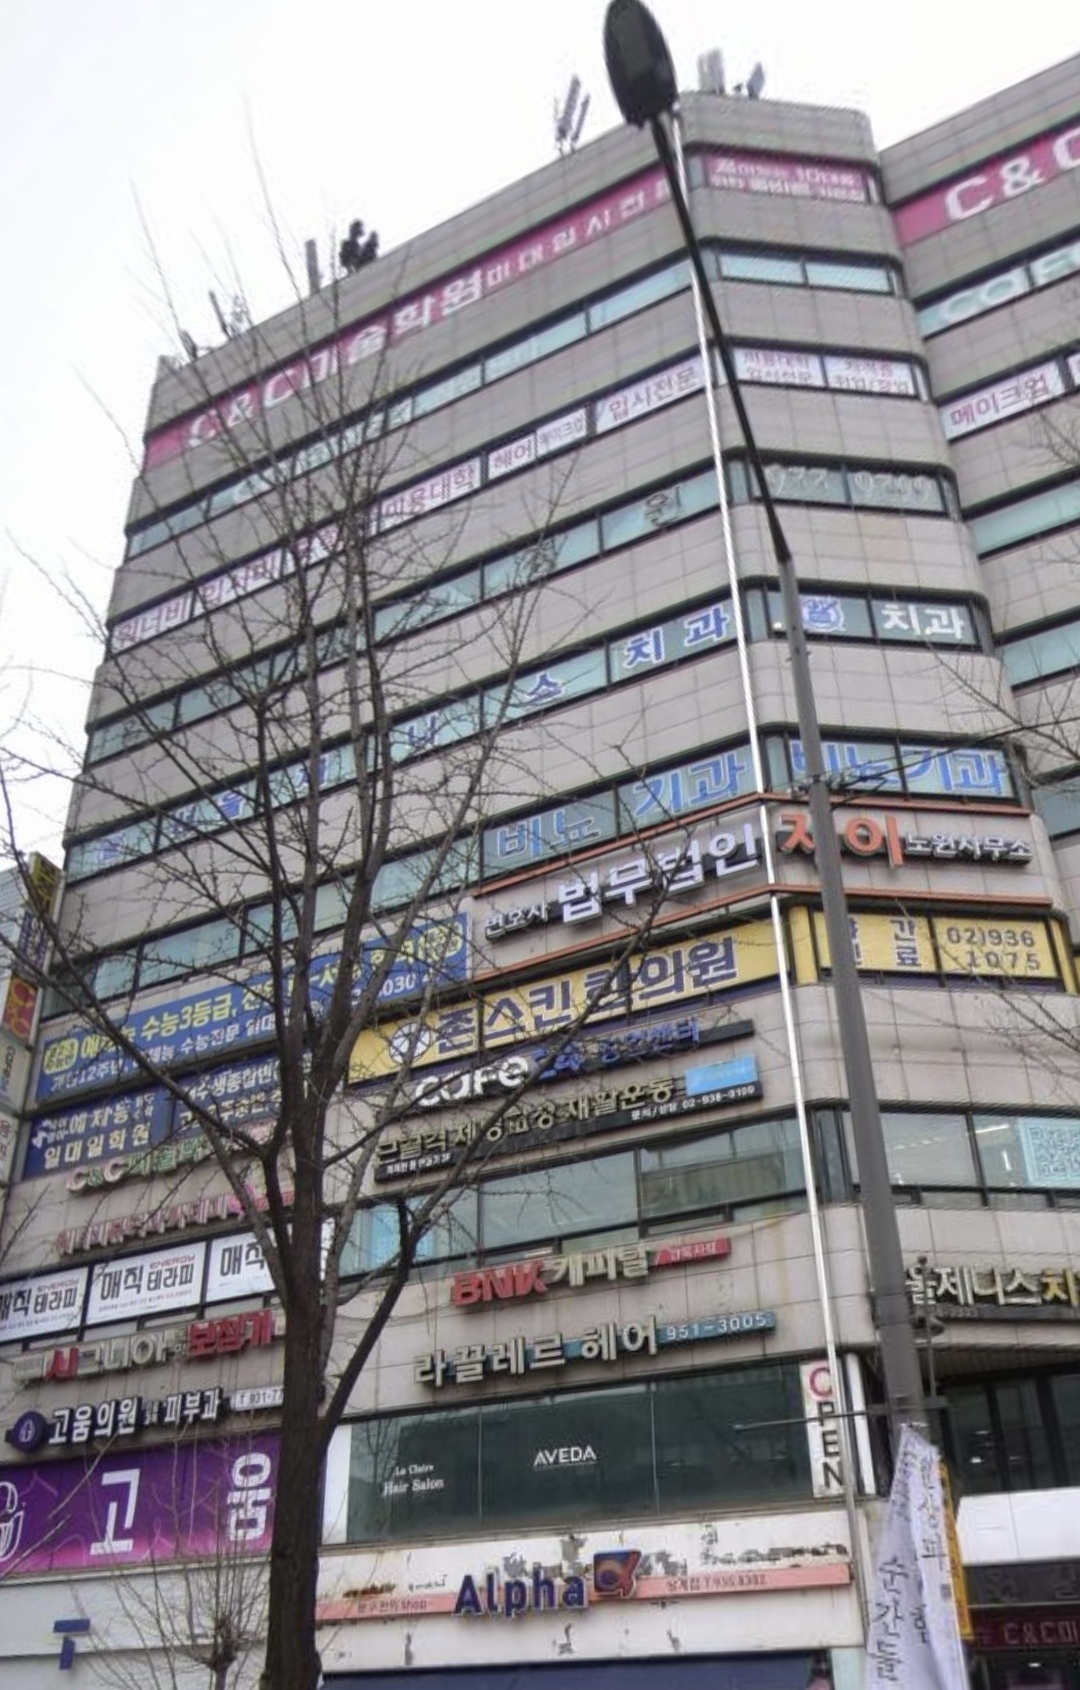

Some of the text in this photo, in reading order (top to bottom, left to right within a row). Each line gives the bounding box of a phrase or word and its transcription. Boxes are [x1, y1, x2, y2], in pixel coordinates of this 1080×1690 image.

[948, 371, 1051, 425] 메이크업
[881, 603, 965, 640] 치과
[557, 823, 758, 922] 법무법인
[947, 926, 1035, 948] 02)936
[966, 950, 1041, 972] 1075
[34, 1286, 78, 1315] 테라피
[99, 1264, 195, 1301] 매직 테라피
[452, 1258, 548, 1305] BNK
[580, 1315, 659, 1362] 헤어
[664, 1312, 768, 1342] 951-3005
[49, 1397, 141, 1445] 고움의원
[164, 1387, 221, 1426] 피부과
[532, 1444, 598, 1469] AVEDA
[452, 1562, 586, 1618] Alpha
